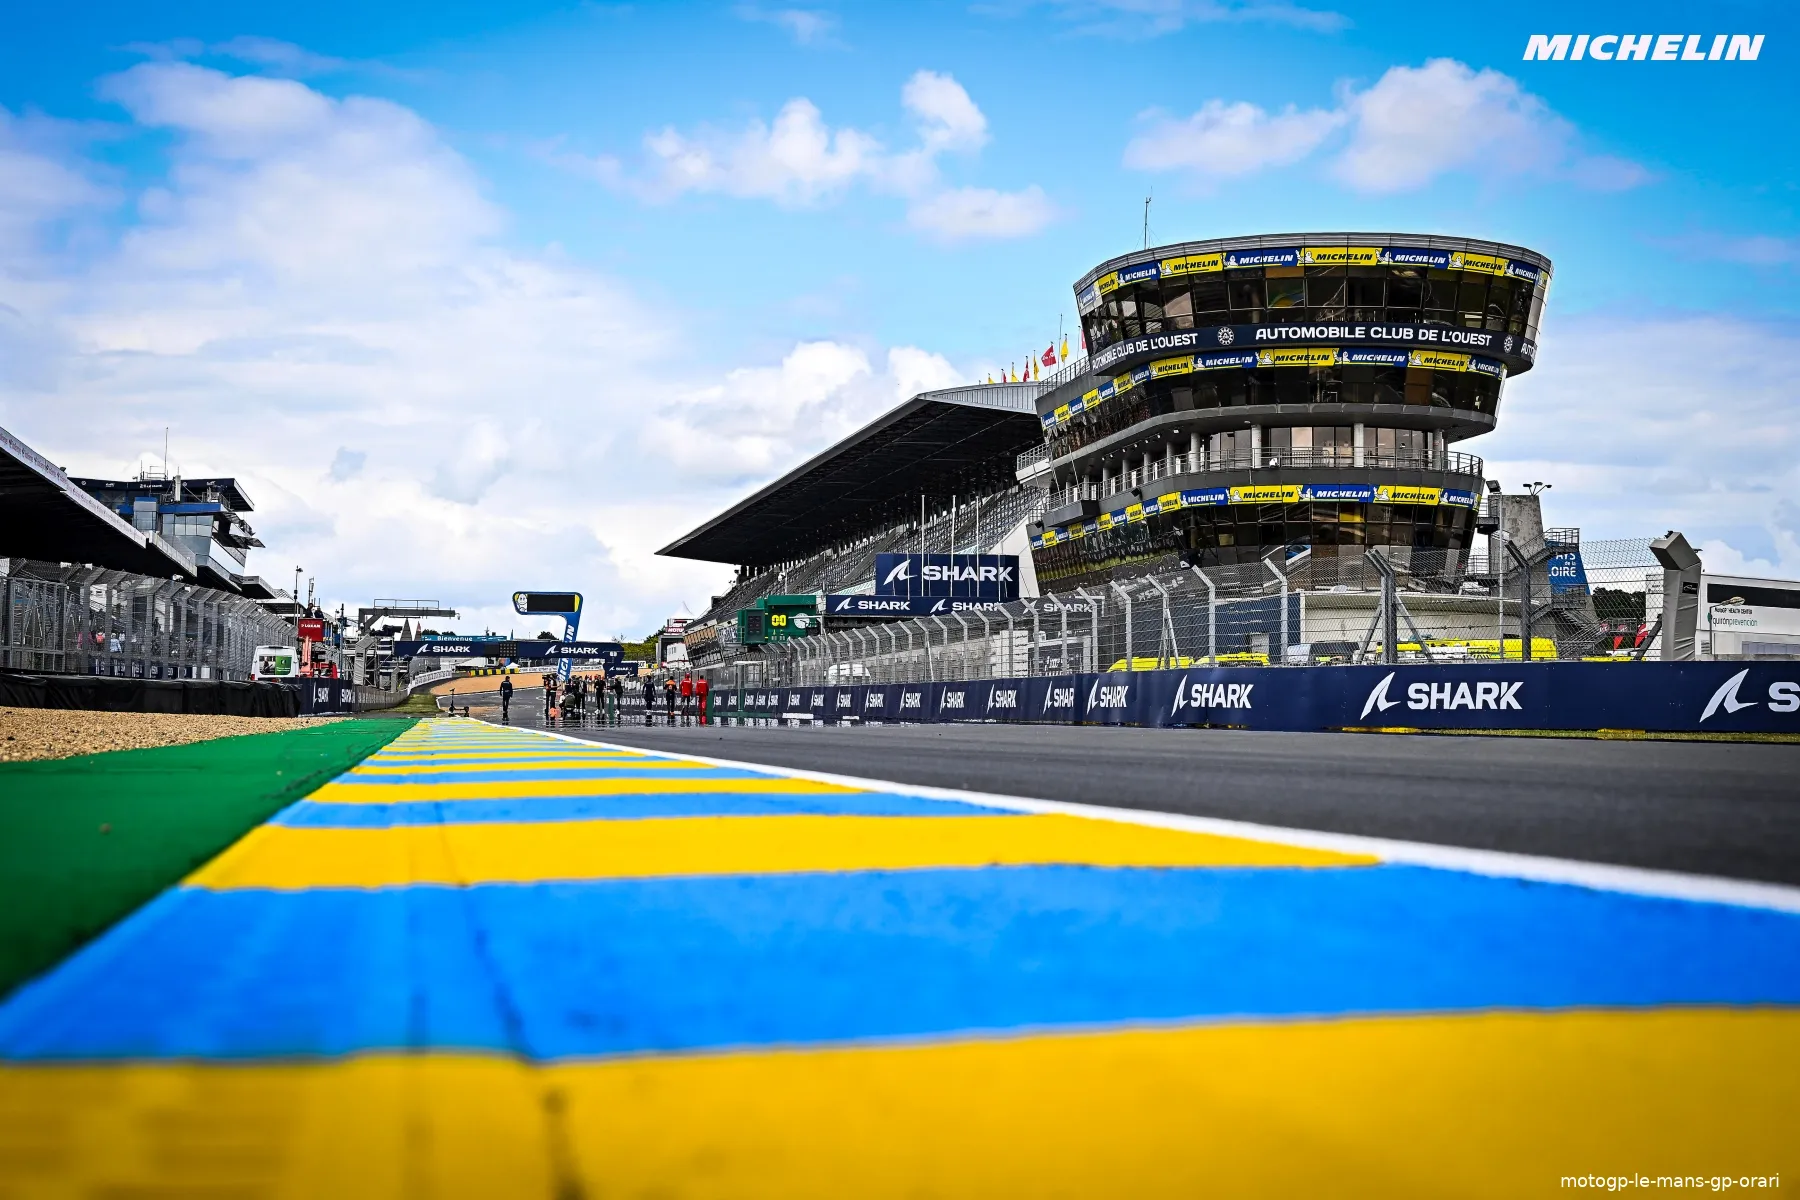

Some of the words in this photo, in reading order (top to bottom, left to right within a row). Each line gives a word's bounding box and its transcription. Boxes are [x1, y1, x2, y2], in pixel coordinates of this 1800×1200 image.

[1239, 254, 1294, 265] MICHELIN
[1315, 252, 1373, 261] MICHELIN
[1394, 254, 1446, 264] MICHELIN
[1173, 259, 1219, 272] MICHELIN
[1464, 259, 1503, 271] MICHELIN
[1124, 268, 1157, 282] MICHELIN
[1255, 327, 1366, 341] AUTOMOBILE
[1370, 327, 1414, 340] CLUB
[1418, 328, 1438, 341] DE
[1441, 330, 1492, 347] L'OUEST
[1117, 343, 1135, 358] CLUB
[1135, 339, 1149, 353] DE
[1150, 332, 1199, 351] L'OUEST
[1205, 356, 1253, 367] MICHELIN
[1275, 353, 1331, 362] MICHELIN
[1351, 353, 1406, 363] MICHELIN
[1423, 357, 1465, 367] MICHELIN
[1158, 361, 1189, 373] MICHELIN
[1187, 493, 1225, 503] MICHELIN
[1243, 491, 1294, 500] MICHELIN
[1316, 491, 1371, 499] MICHELIN
[1391, 492, 1436, 501] MICHELIN
[1449, 495, 1474, 505] MICHELIN
[923, 564, 1013, 582] SHARK
[858, 600, 911, 611] SHARK
[952, 601, 1002, 612] SHARK
[432, 645, 471, 653] SHARK
[560, 647, 599, 655] SHARK
[840, 693, 852, 708] SHARK
[869, 693, 885, 708] SHARK
[905, 692, 922, 708] SHARK
[946, 691, 965, 709] SHARK
[995, 689, 1017, 708] SHARK
[1053, 688, 1075, 707] SHAR
[1099, 685, 1129, 708] SHARK
[1190, 683, 1254, 709] SHARK
[1406, 681, 1525, 710] SHARK
